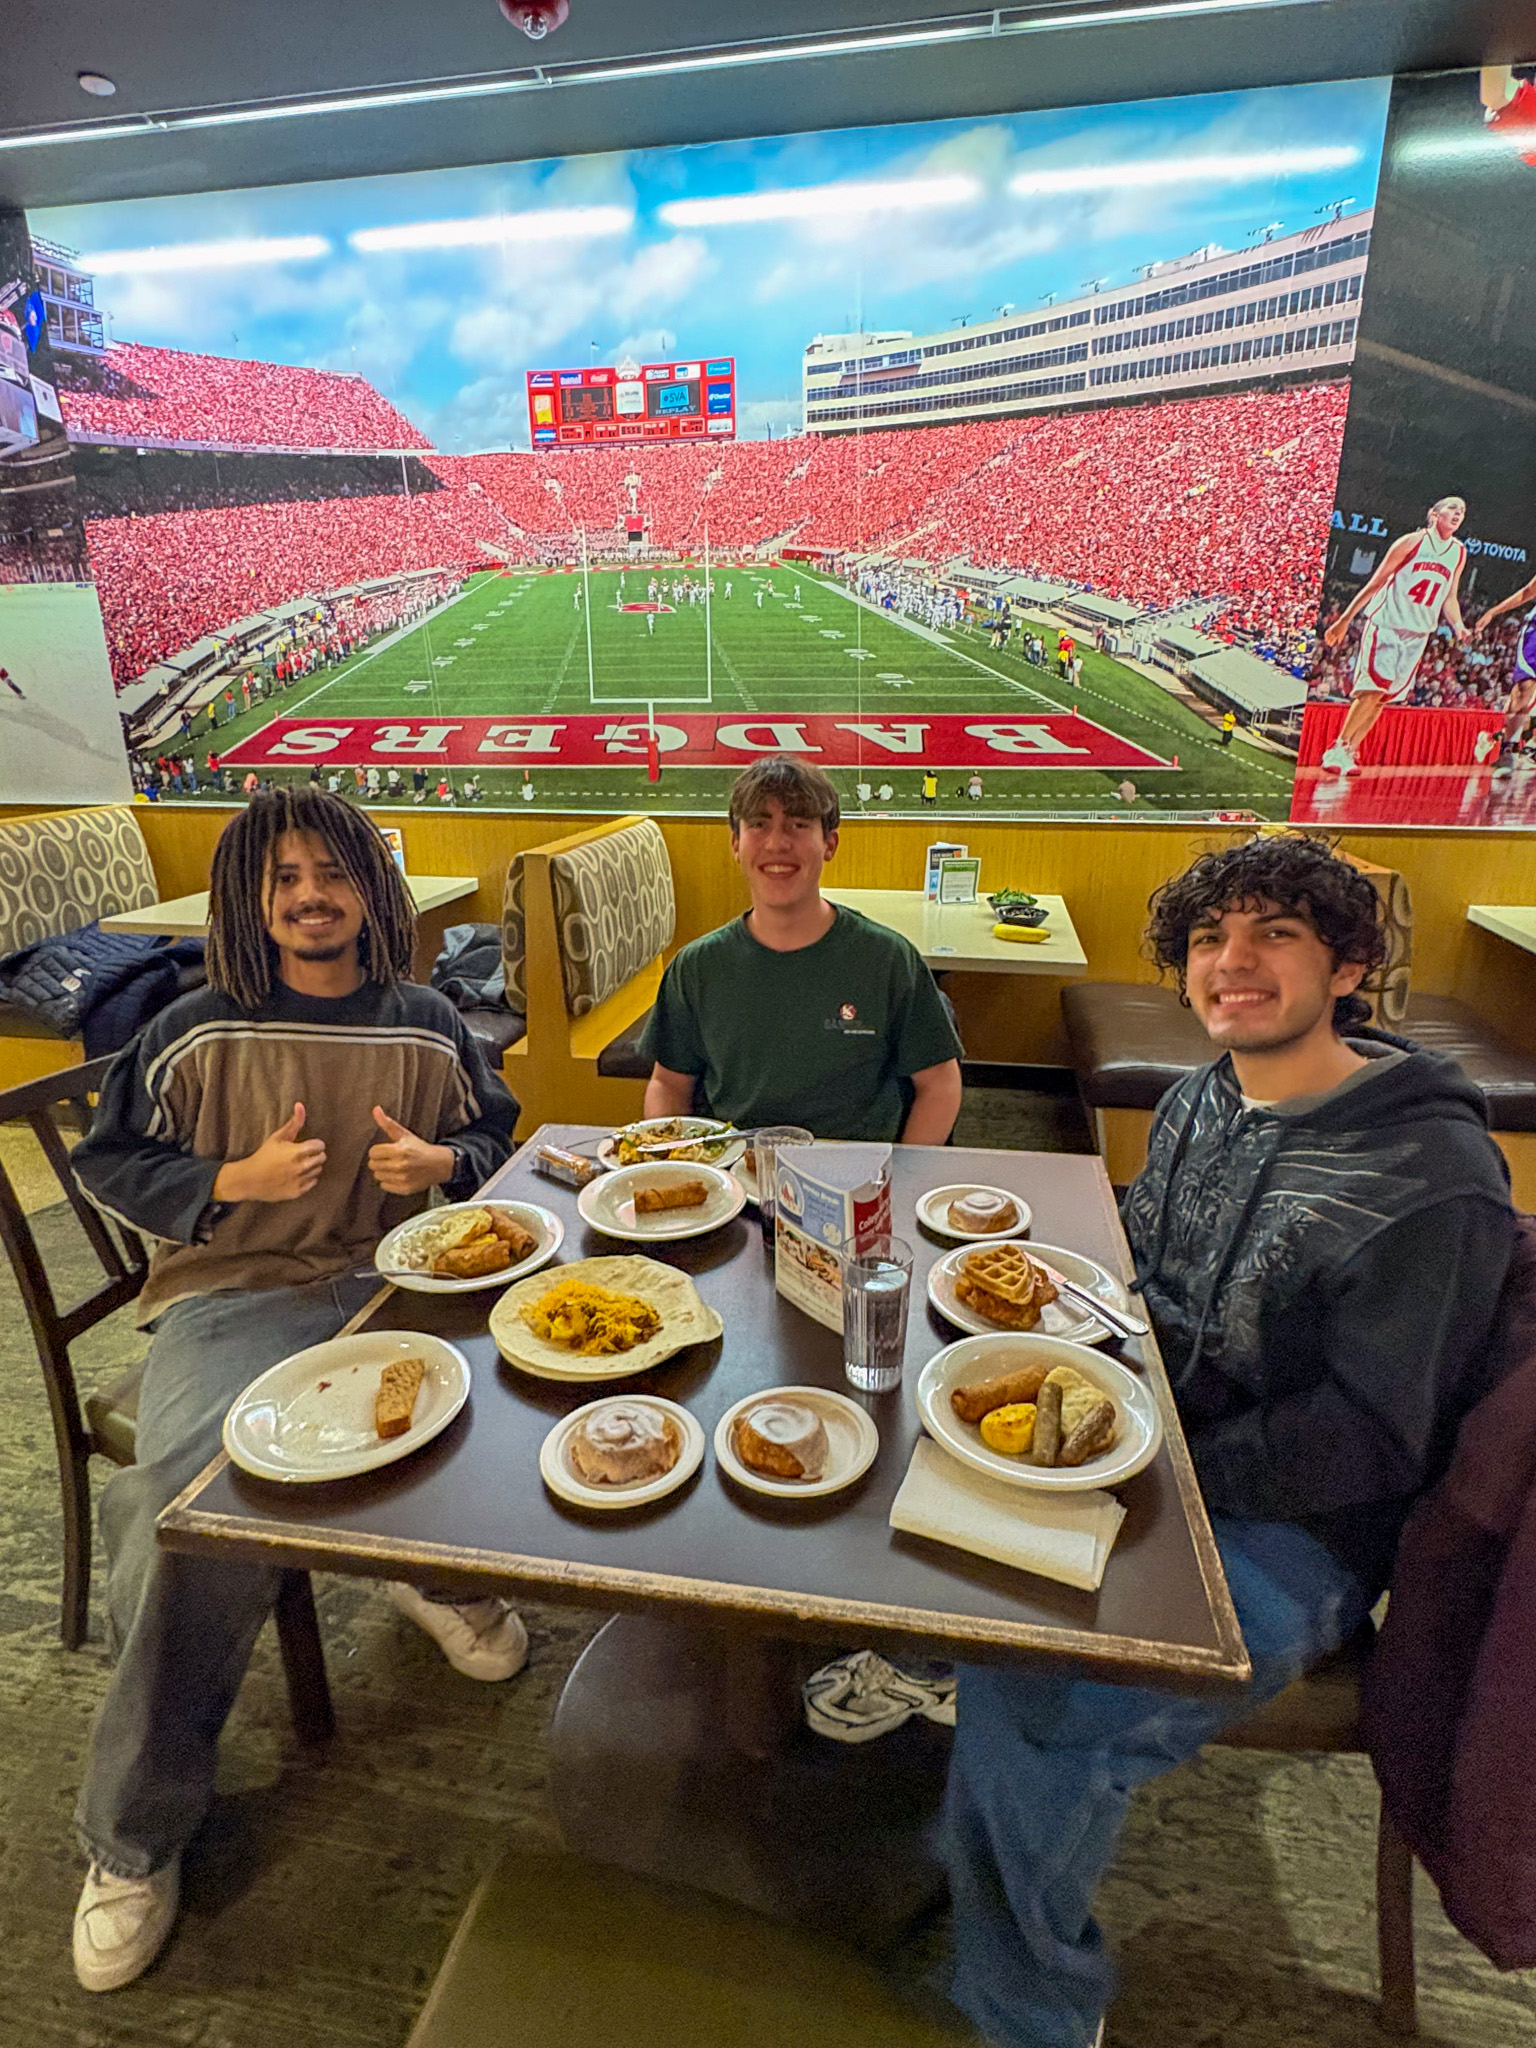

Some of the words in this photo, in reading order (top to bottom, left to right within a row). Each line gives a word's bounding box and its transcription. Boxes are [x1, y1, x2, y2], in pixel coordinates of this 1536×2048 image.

[669, 391, 687, 403] SVA
[1483, 542, 1527, 562] TOYOTA
[1407, 578, 1442, 607] 41
[265, 722, 1092, 755] BADGERS
